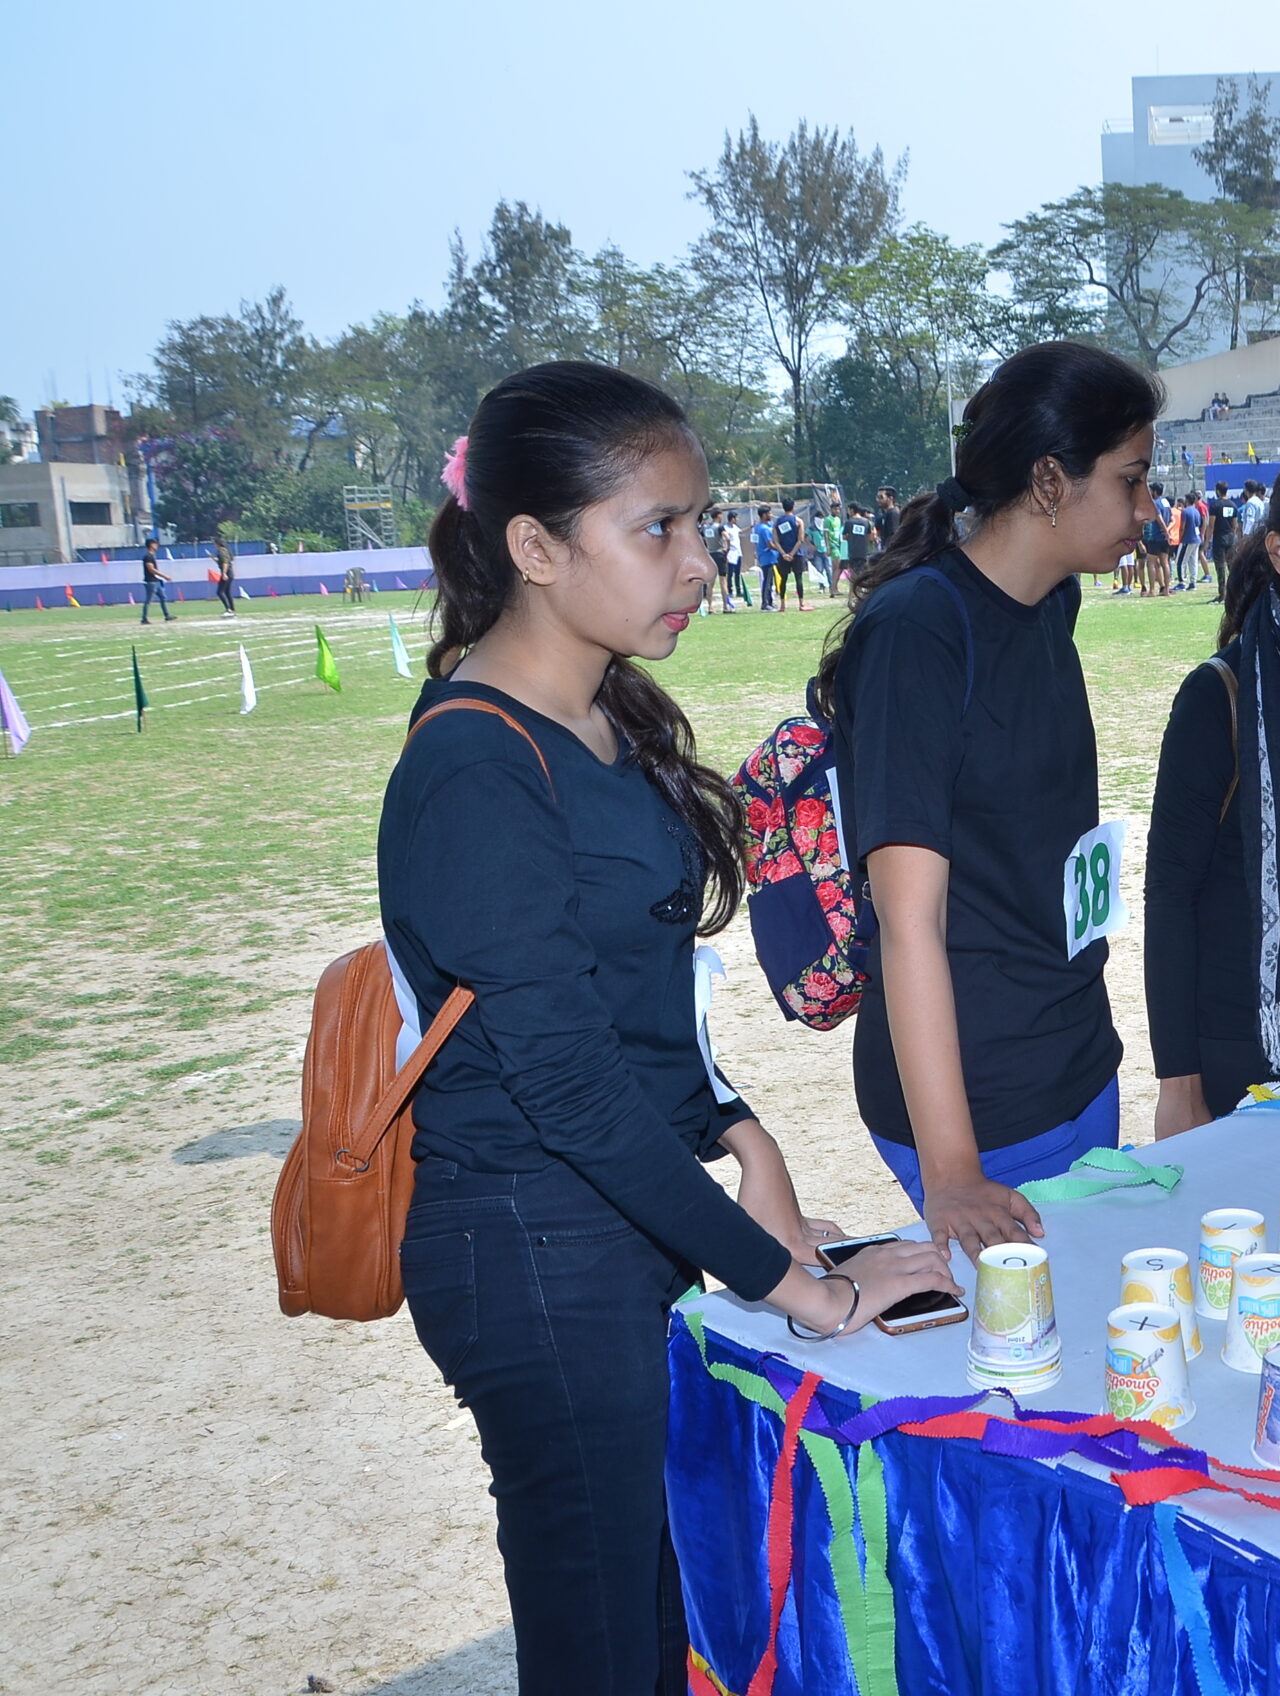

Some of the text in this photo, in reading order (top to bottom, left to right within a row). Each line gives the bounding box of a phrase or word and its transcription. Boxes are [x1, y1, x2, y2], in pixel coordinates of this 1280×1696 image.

[1074, 842, 1110, 940] 38
[1146, 1258, 1164, 1271] S
[1129, 1316, 1160, 1331] X
